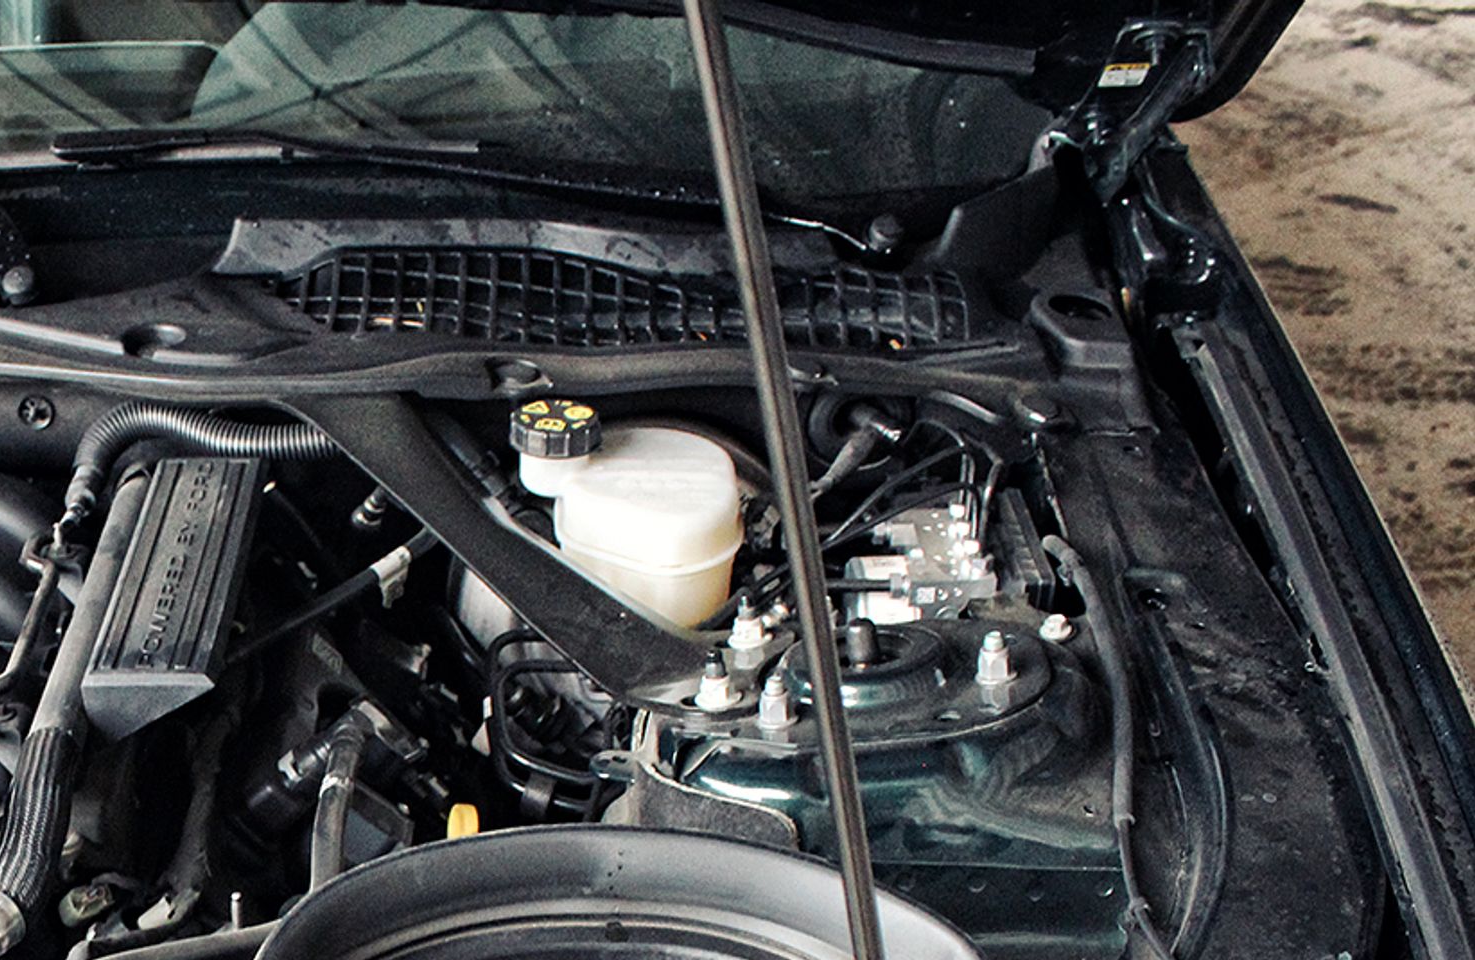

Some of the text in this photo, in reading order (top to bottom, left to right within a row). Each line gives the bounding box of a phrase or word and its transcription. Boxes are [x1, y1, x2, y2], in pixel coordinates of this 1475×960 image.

[136, 461, 215, 668] POWERED BY FORD
